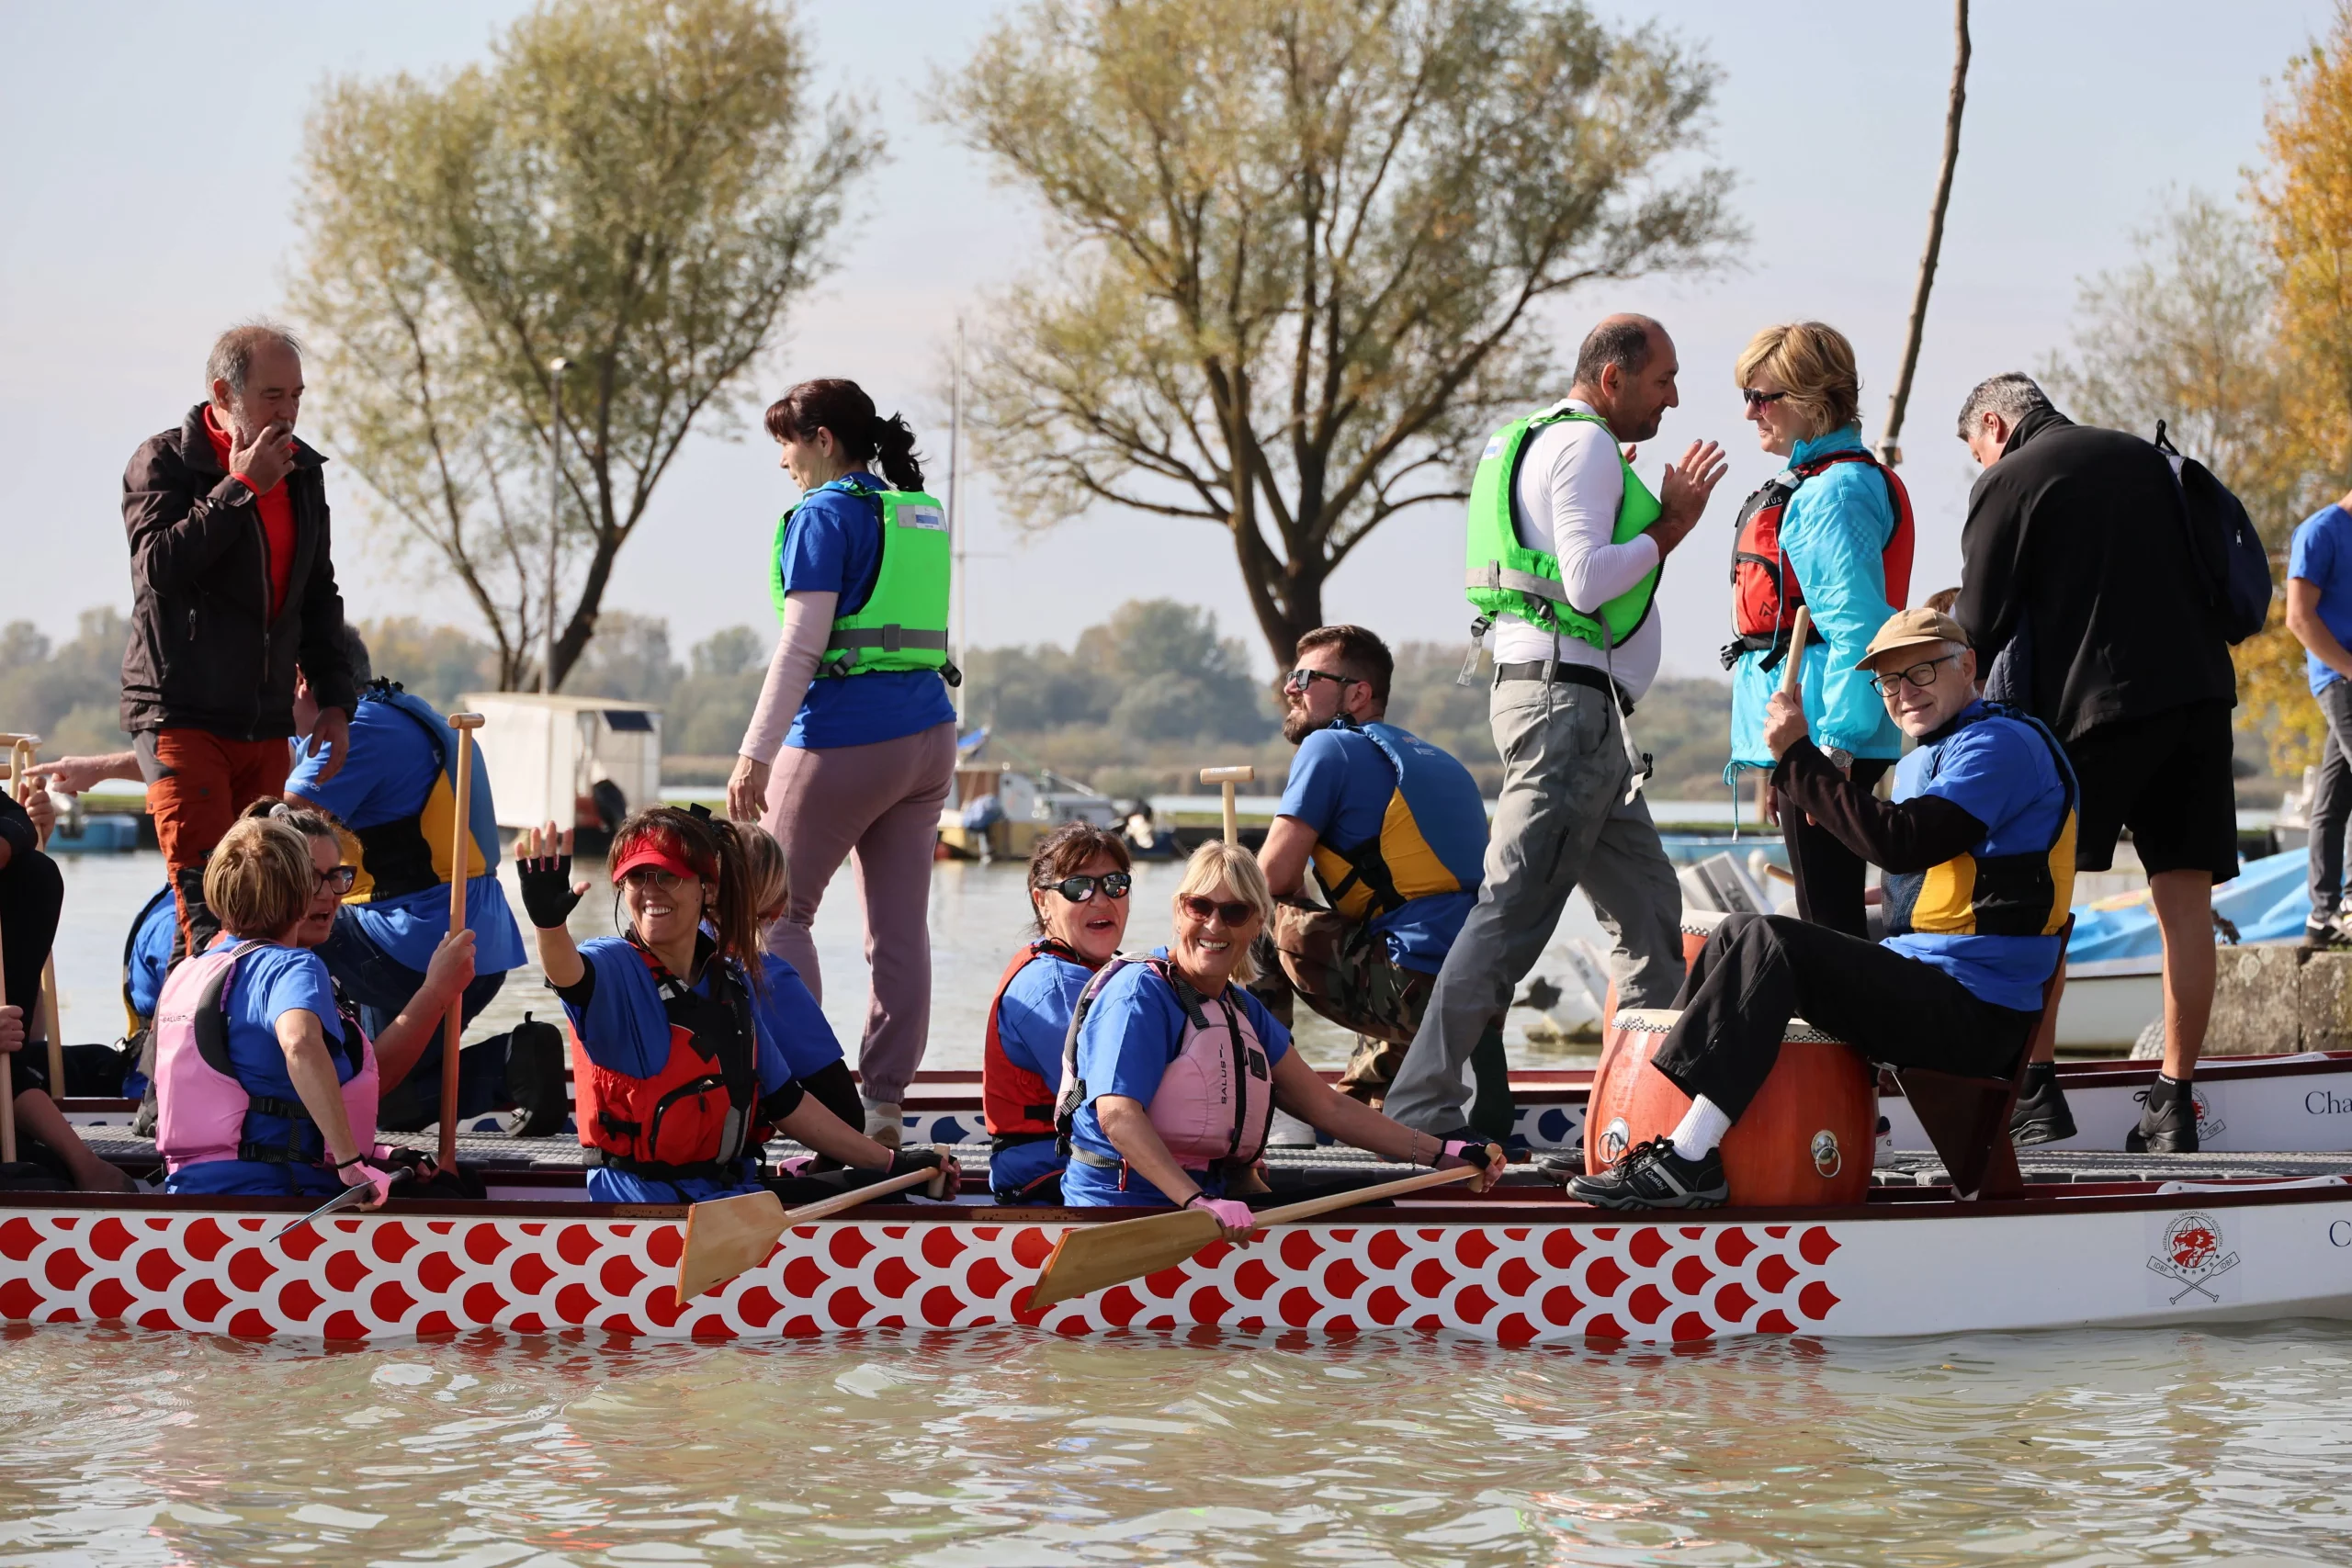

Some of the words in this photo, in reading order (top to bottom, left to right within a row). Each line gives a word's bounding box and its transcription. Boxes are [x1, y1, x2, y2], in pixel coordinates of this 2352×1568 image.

[1747, 496, 1782, 524] AQUARIUS
[2305, 1090, 2352, 1115] Cha
[2208, 1124, 2220, 1136] IDBF
[2162, 1217, 2179, 1252] INTERNATIONAL
[2178, 1210, 2200, 1220] DRAGON
[2200, 1212, 2212, 1221] BOAT
[2211, 1219, 2223, 1247] FEDERATION
[2153, 1261, 2168, 1273] IDBF
[2219, 1258, 2234, 1270] IDBF
